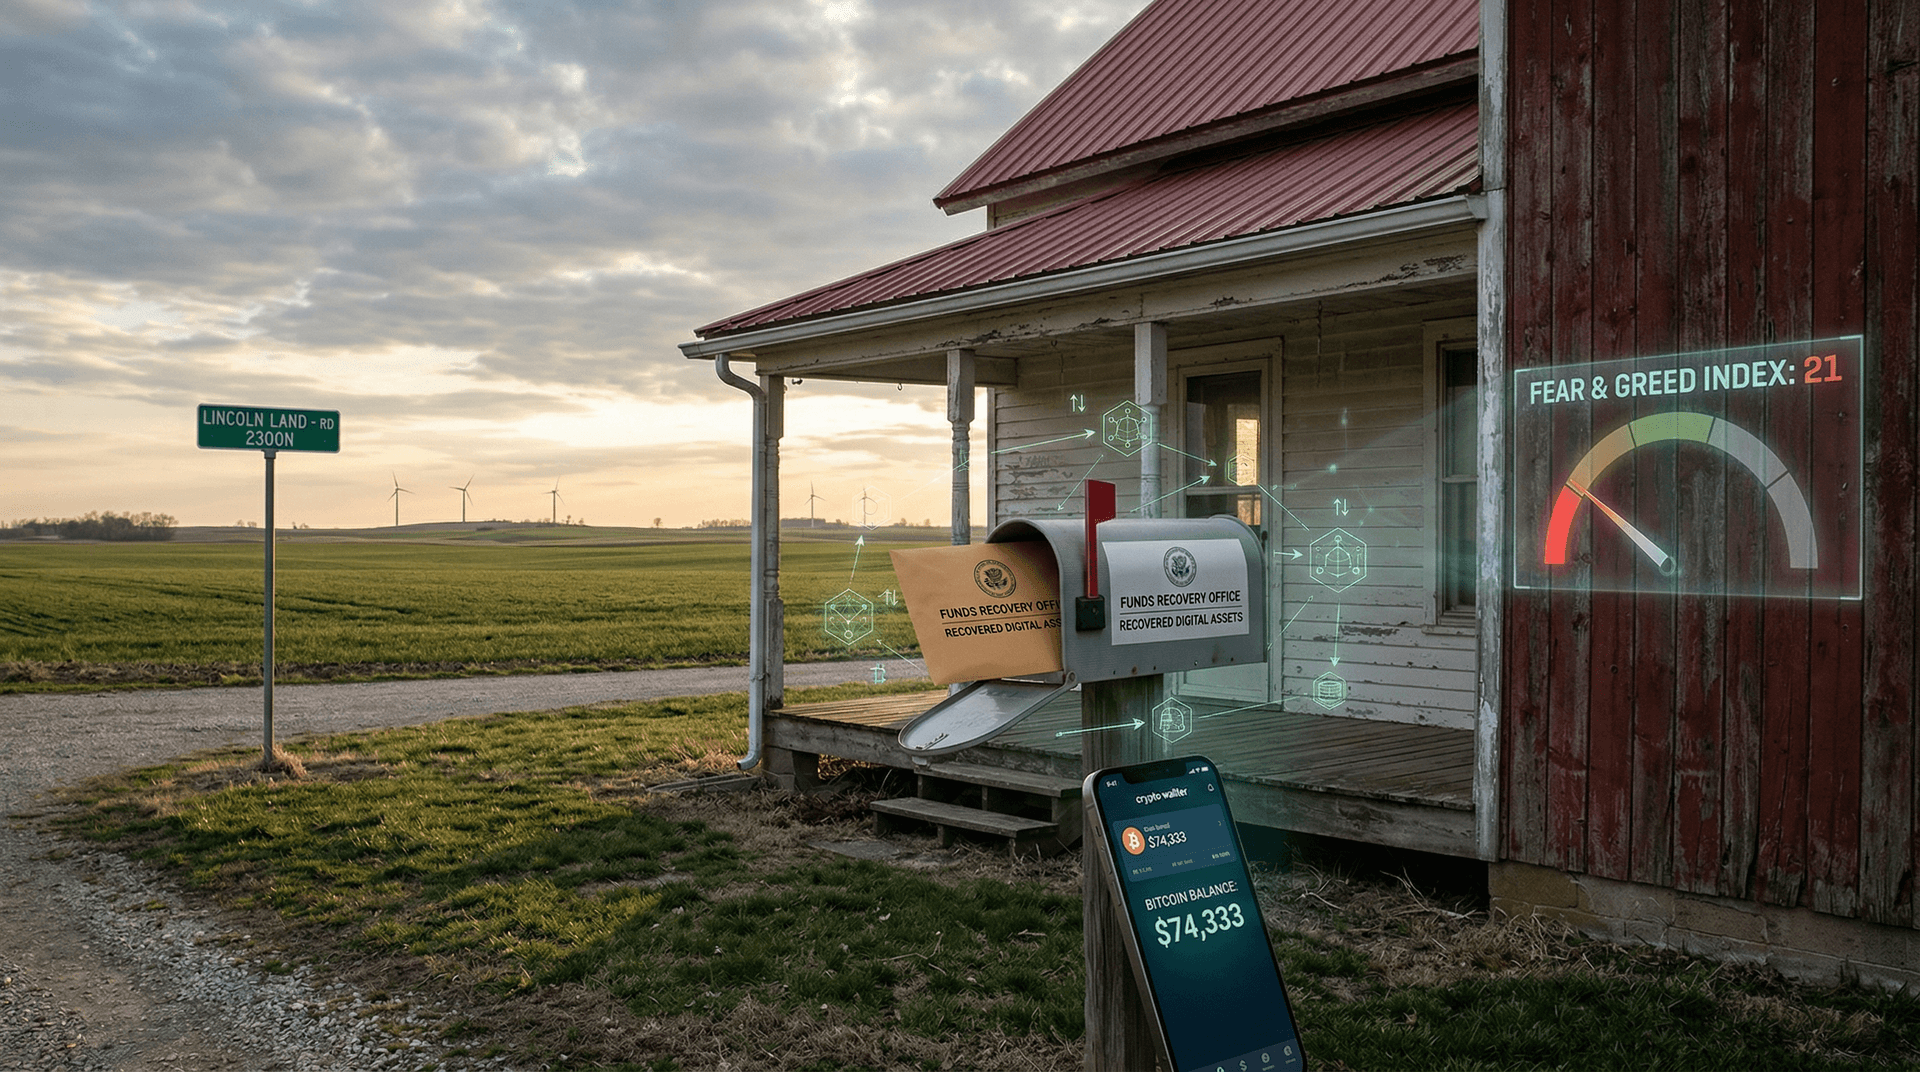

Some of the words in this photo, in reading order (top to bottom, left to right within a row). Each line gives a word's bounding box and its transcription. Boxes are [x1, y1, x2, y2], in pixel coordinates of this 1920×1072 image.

[203, 409, 264, 427] LINCOLN
[270, 413, 307, 429] LAND
[320, 418, 334, 430] RD
[246, 430, 294, 447] 2300N
[1120, 595, 1155, 609] FUNDS
[1157, 592, 1207, 607] RECOVERY
[1208, 590, 1241, 603] OFFICE
[940, 606, 978, 620] FUNDS
[979, 602, 1033, 616] RECOVERY
[944, 623, 1004, 637] RECOVERED
[1004, 620, 1042, 632] DIGITAL
[1119, 616, 1174, 631] RECOVERED
[1175, 614, 1209, 627] DIGITAL
[1210, 611, 1243, 625] ASSETS
[1135, 791, 1162, 805] crypto
[1147, 831, 1187, 849] $74,333
[1144, 891, 1188, 911] BITCOIN
[1189, 880, 1239, 901] BALANCE:
[1154, 903, 1245, 948] $74,333
